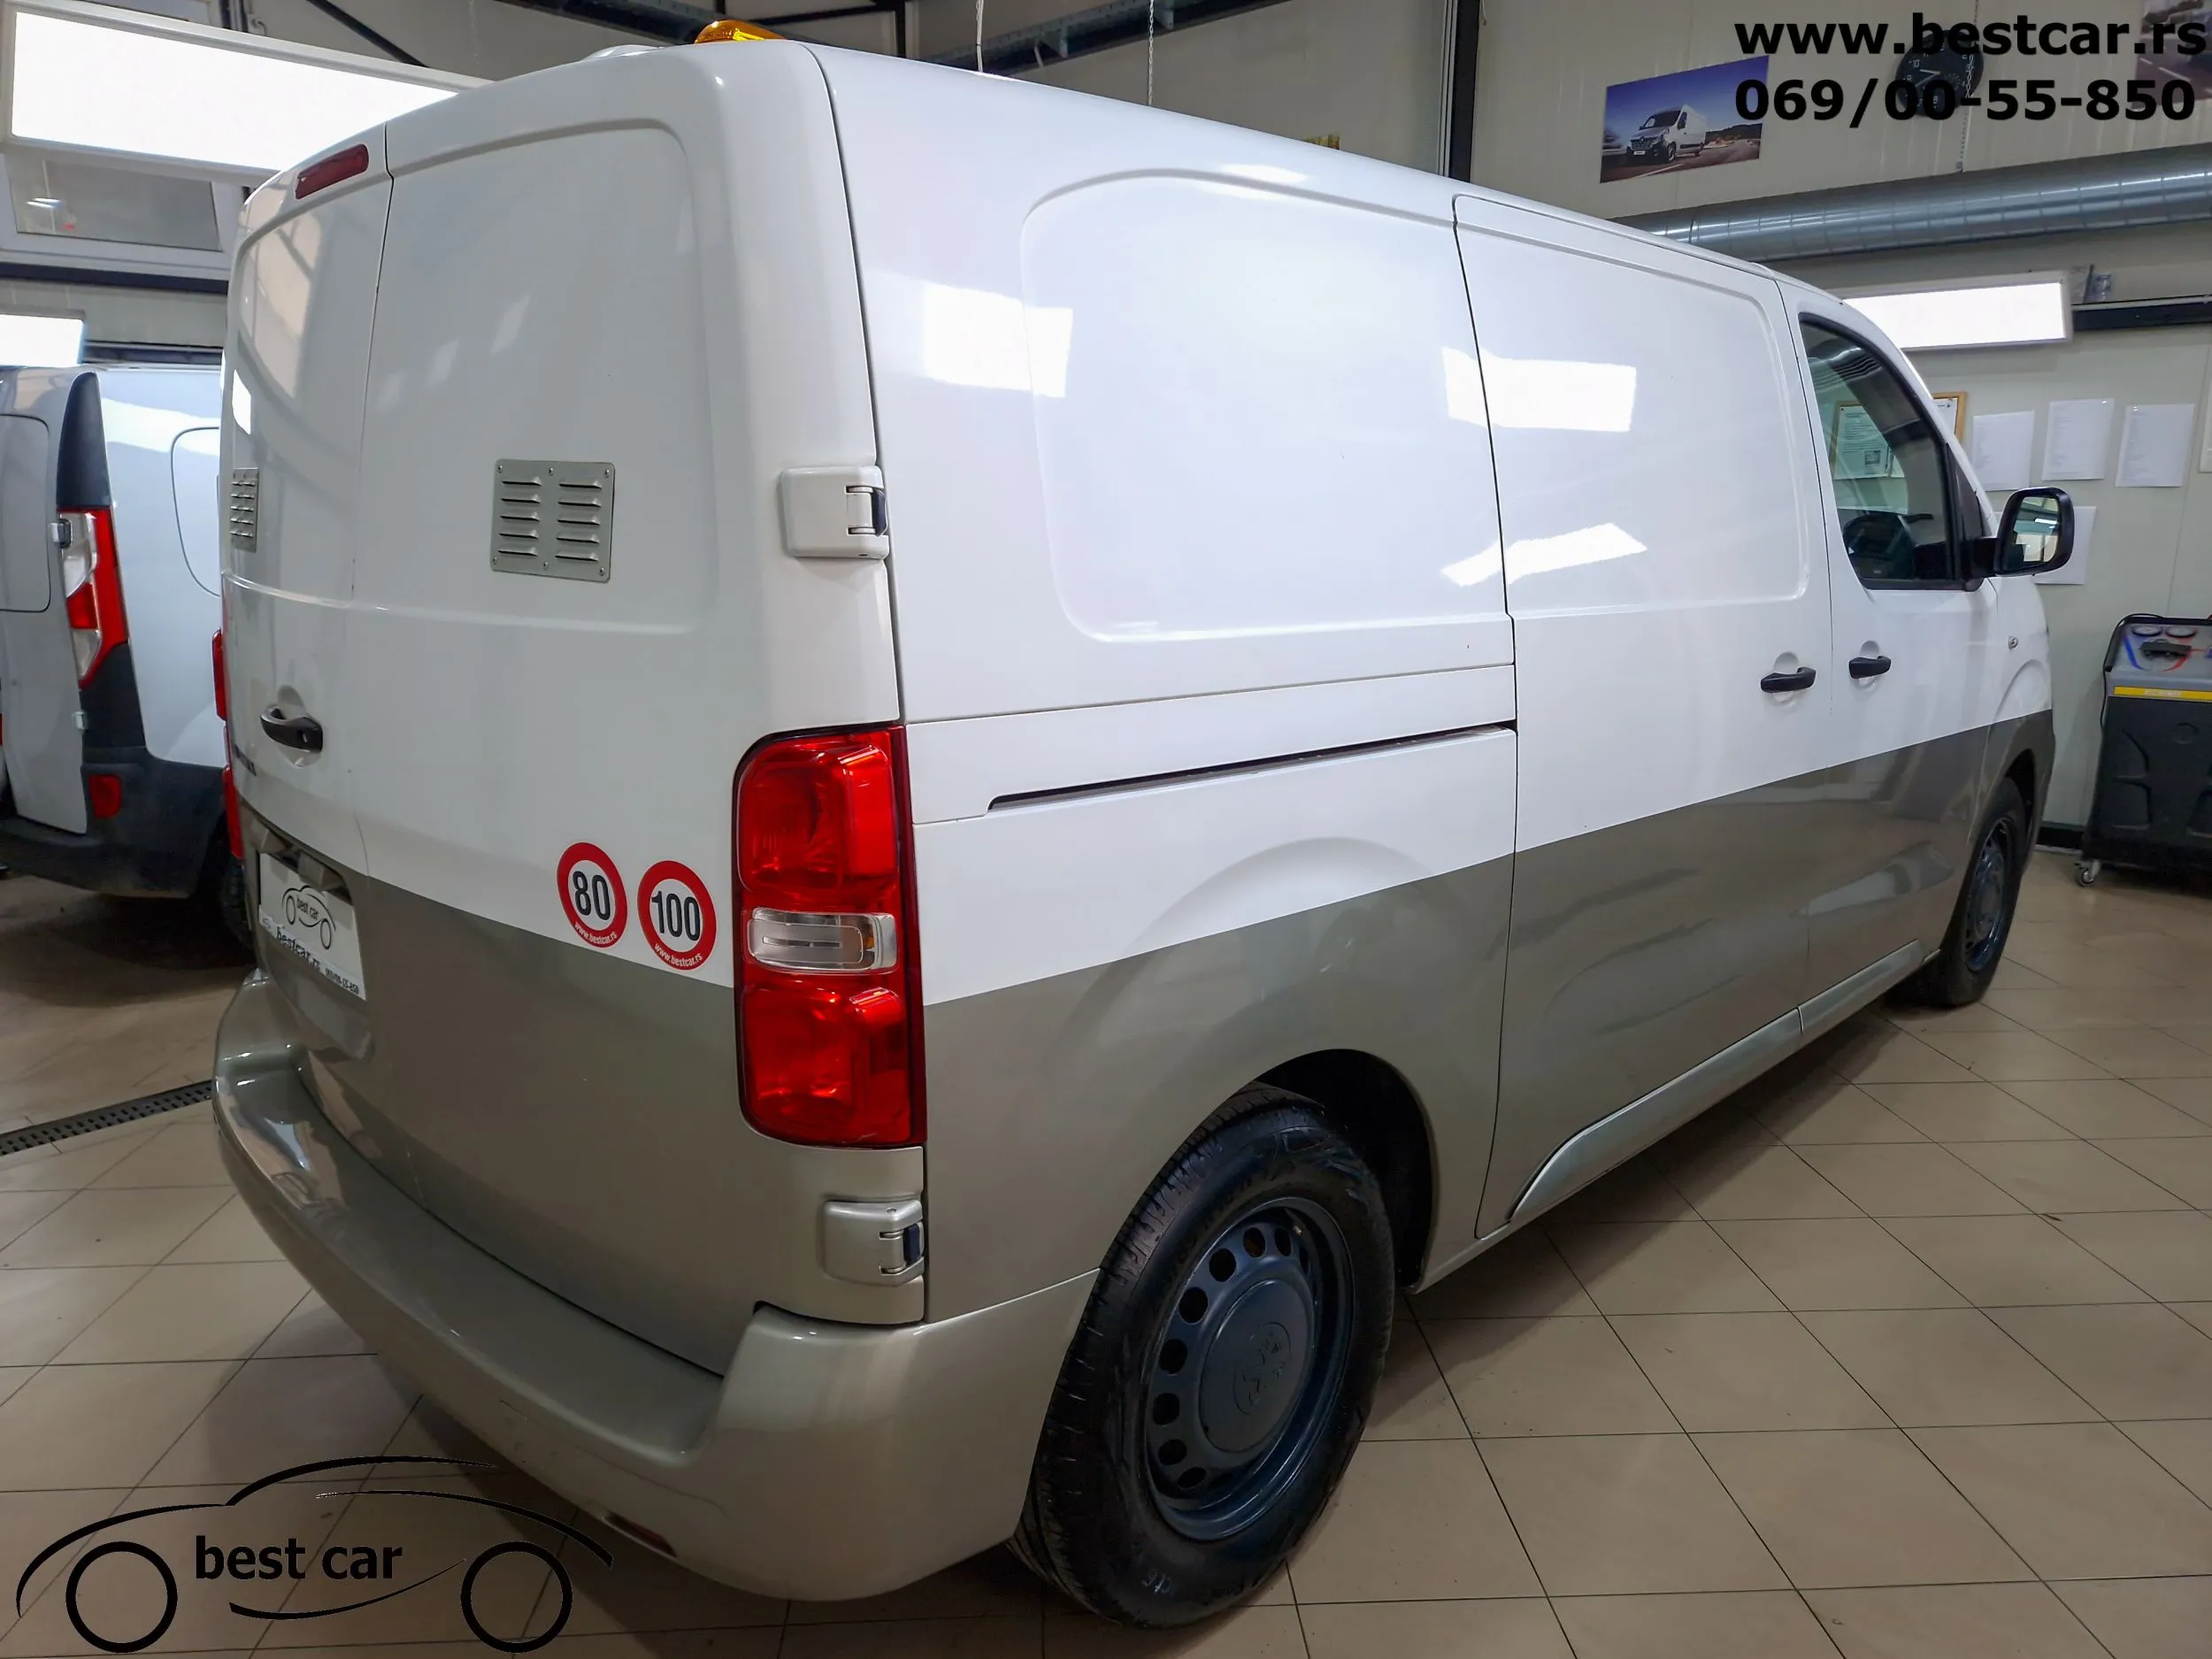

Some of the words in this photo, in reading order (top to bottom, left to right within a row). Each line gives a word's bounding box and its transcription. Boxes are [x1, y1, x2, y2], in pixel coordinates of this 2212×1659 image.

[572, 871, 611, 921] 80
[574, 923, 617, 943] www.bestcar.rs
[651, 890, 701, 941] 100
[654, 943, 703, 967] www.bestcar.rs
